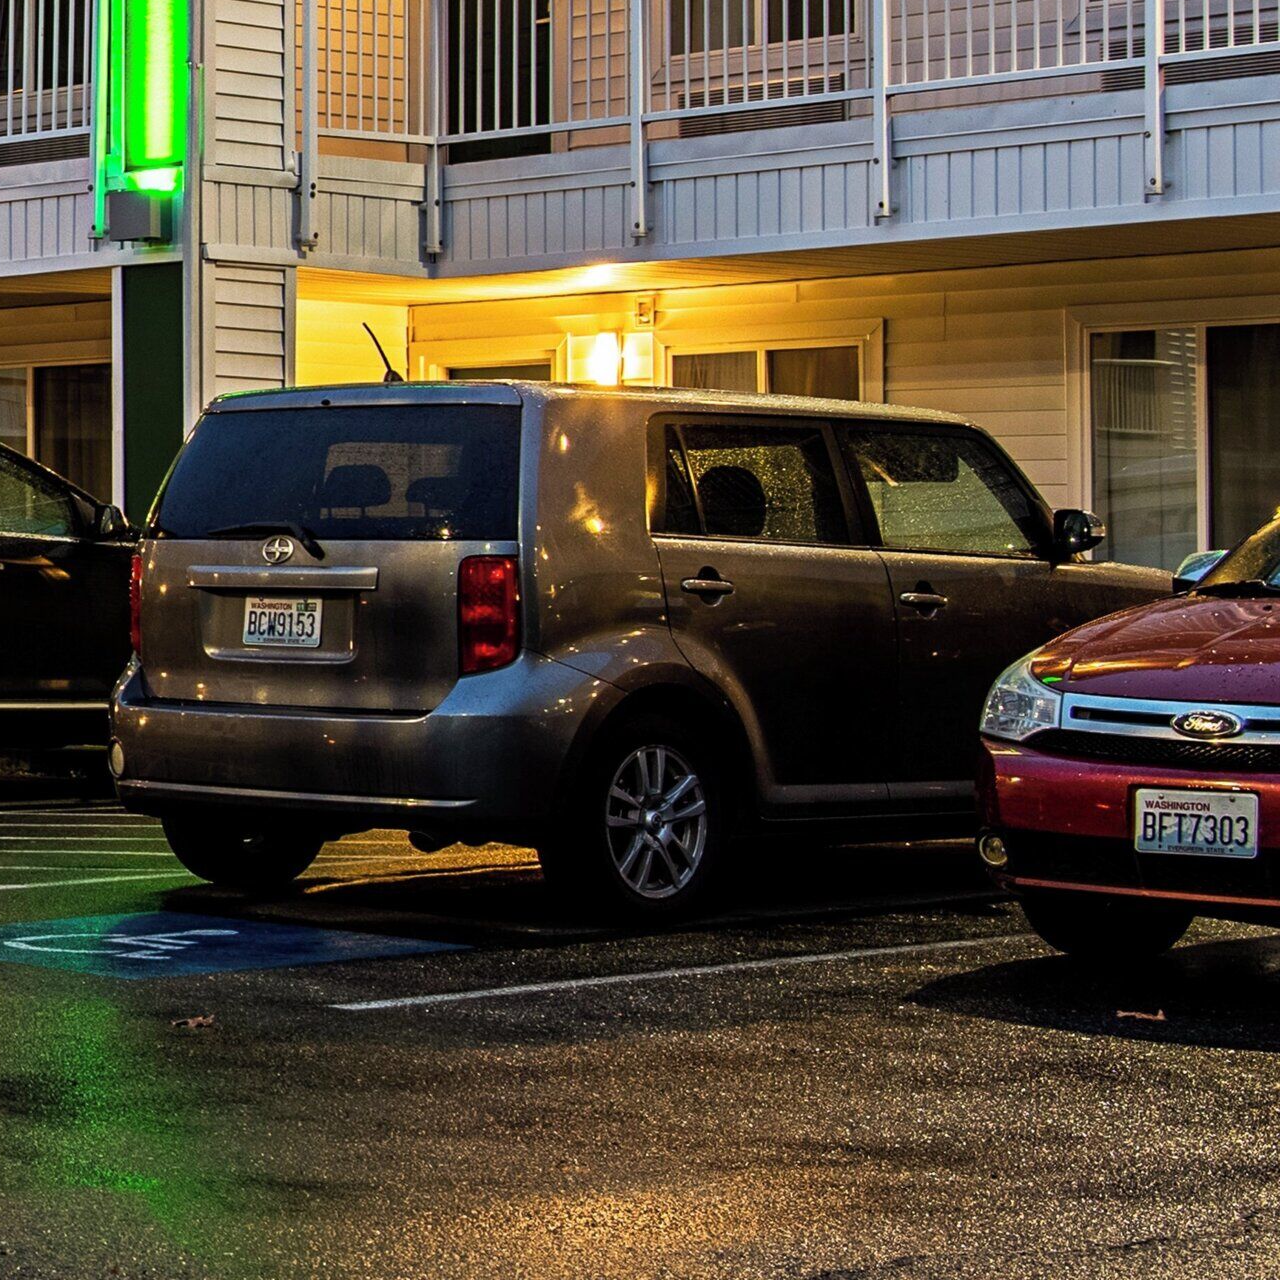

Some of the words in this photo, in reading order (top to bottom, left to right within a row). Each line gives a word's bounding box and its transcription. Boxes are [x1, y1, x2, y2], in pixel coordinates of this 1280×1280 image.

[251, 602, 293, 610] WASHINGTON
[247, 610, 316, 638] BCW9153
[1183, 714, 1224, 732] Ford
[1144, 800, 1211, 812] WASHINGTON
[1142, 811, 1250, 847] BFT7303
